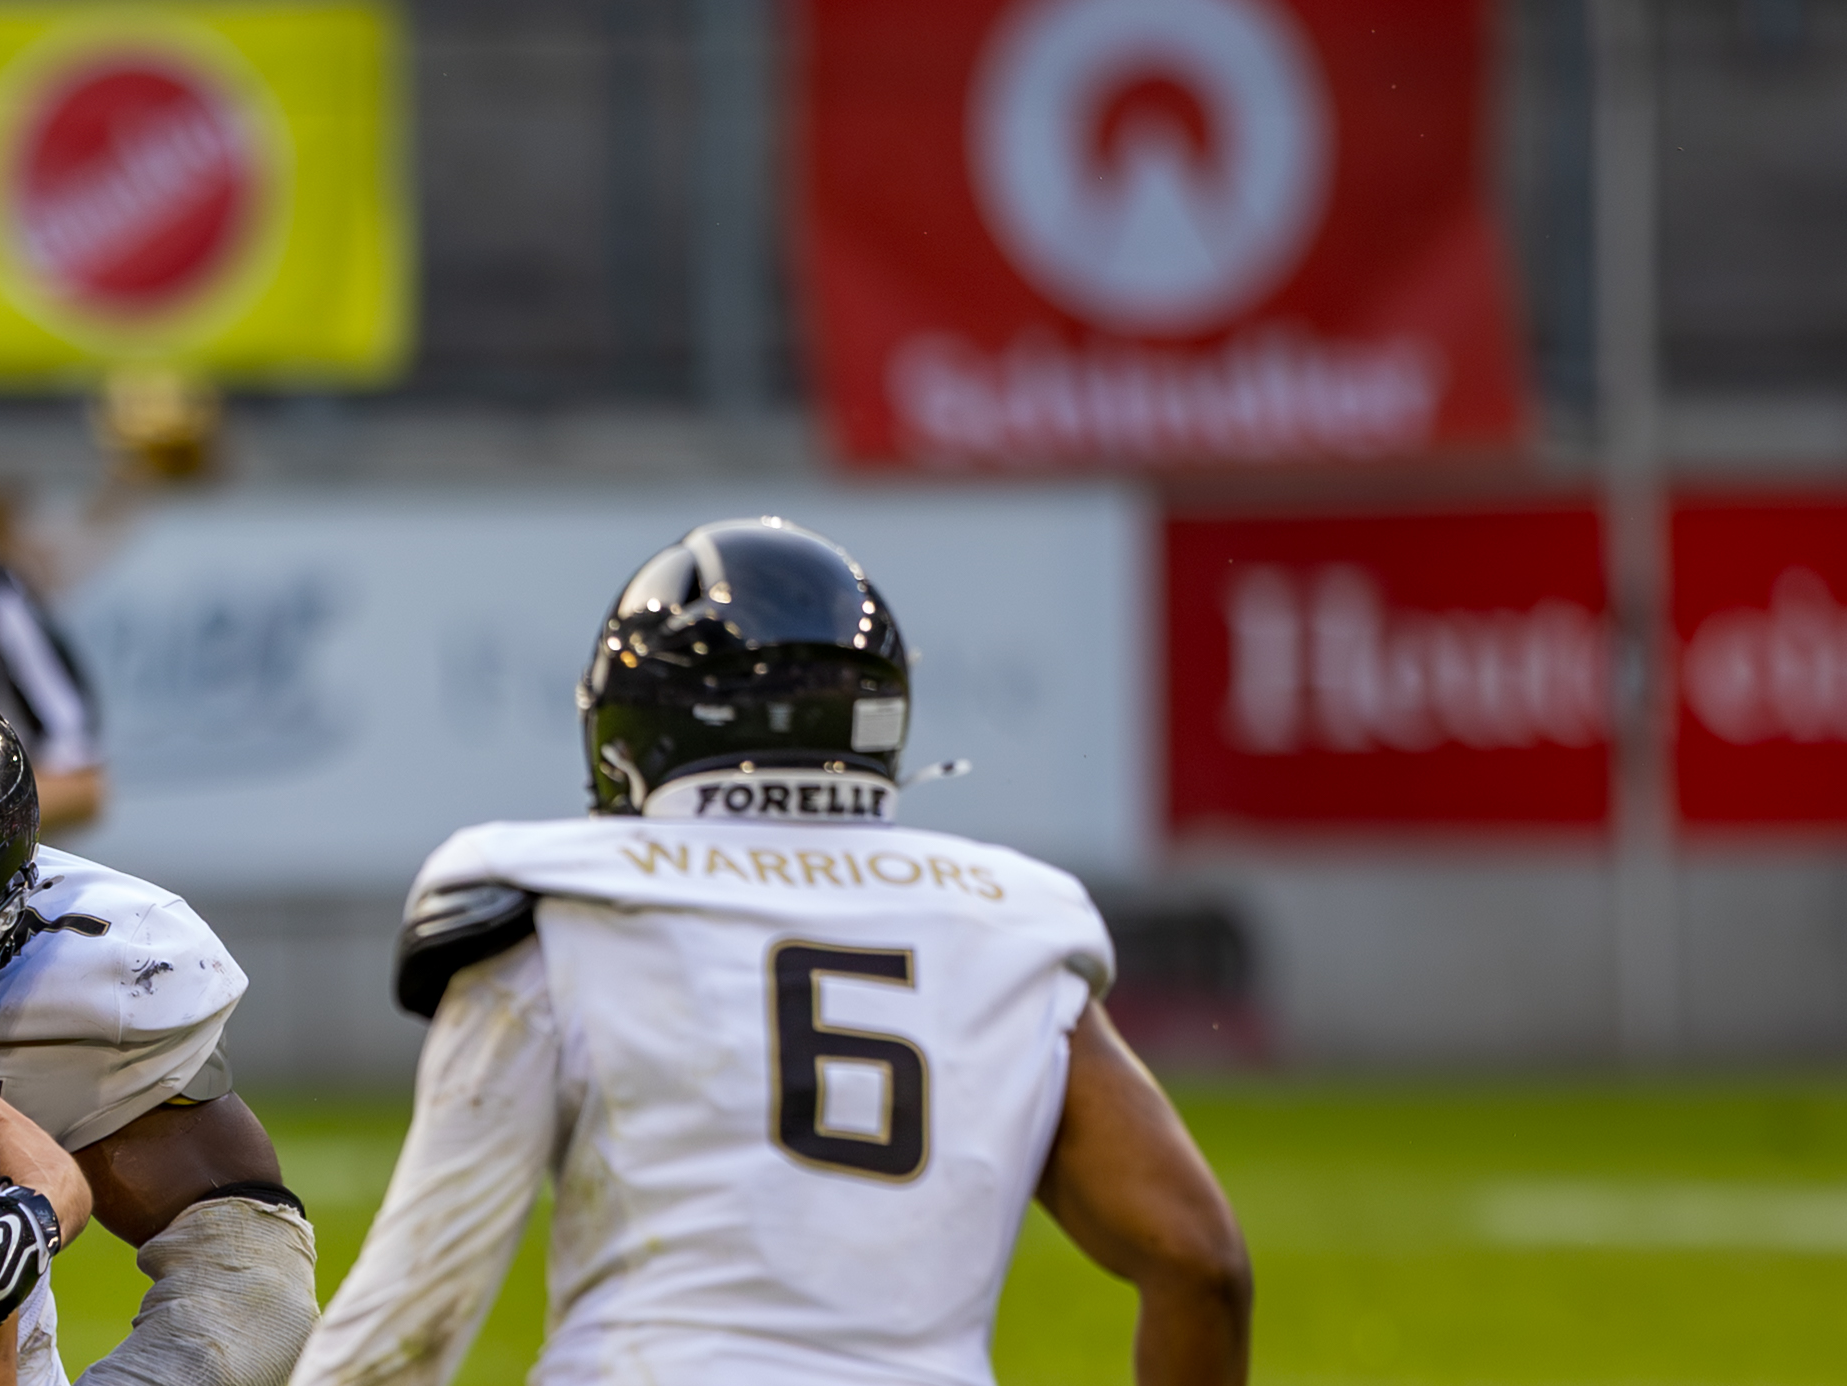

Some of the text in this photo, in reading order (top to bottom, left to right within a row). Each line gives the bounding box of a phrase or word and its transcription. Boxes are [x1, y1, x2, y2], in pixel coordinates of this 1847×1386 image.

[694, 783, 889, 817] FORELLE
[618, 836, 1006, 901] WARRIORS
[765, 938, 930, 1185] 6
